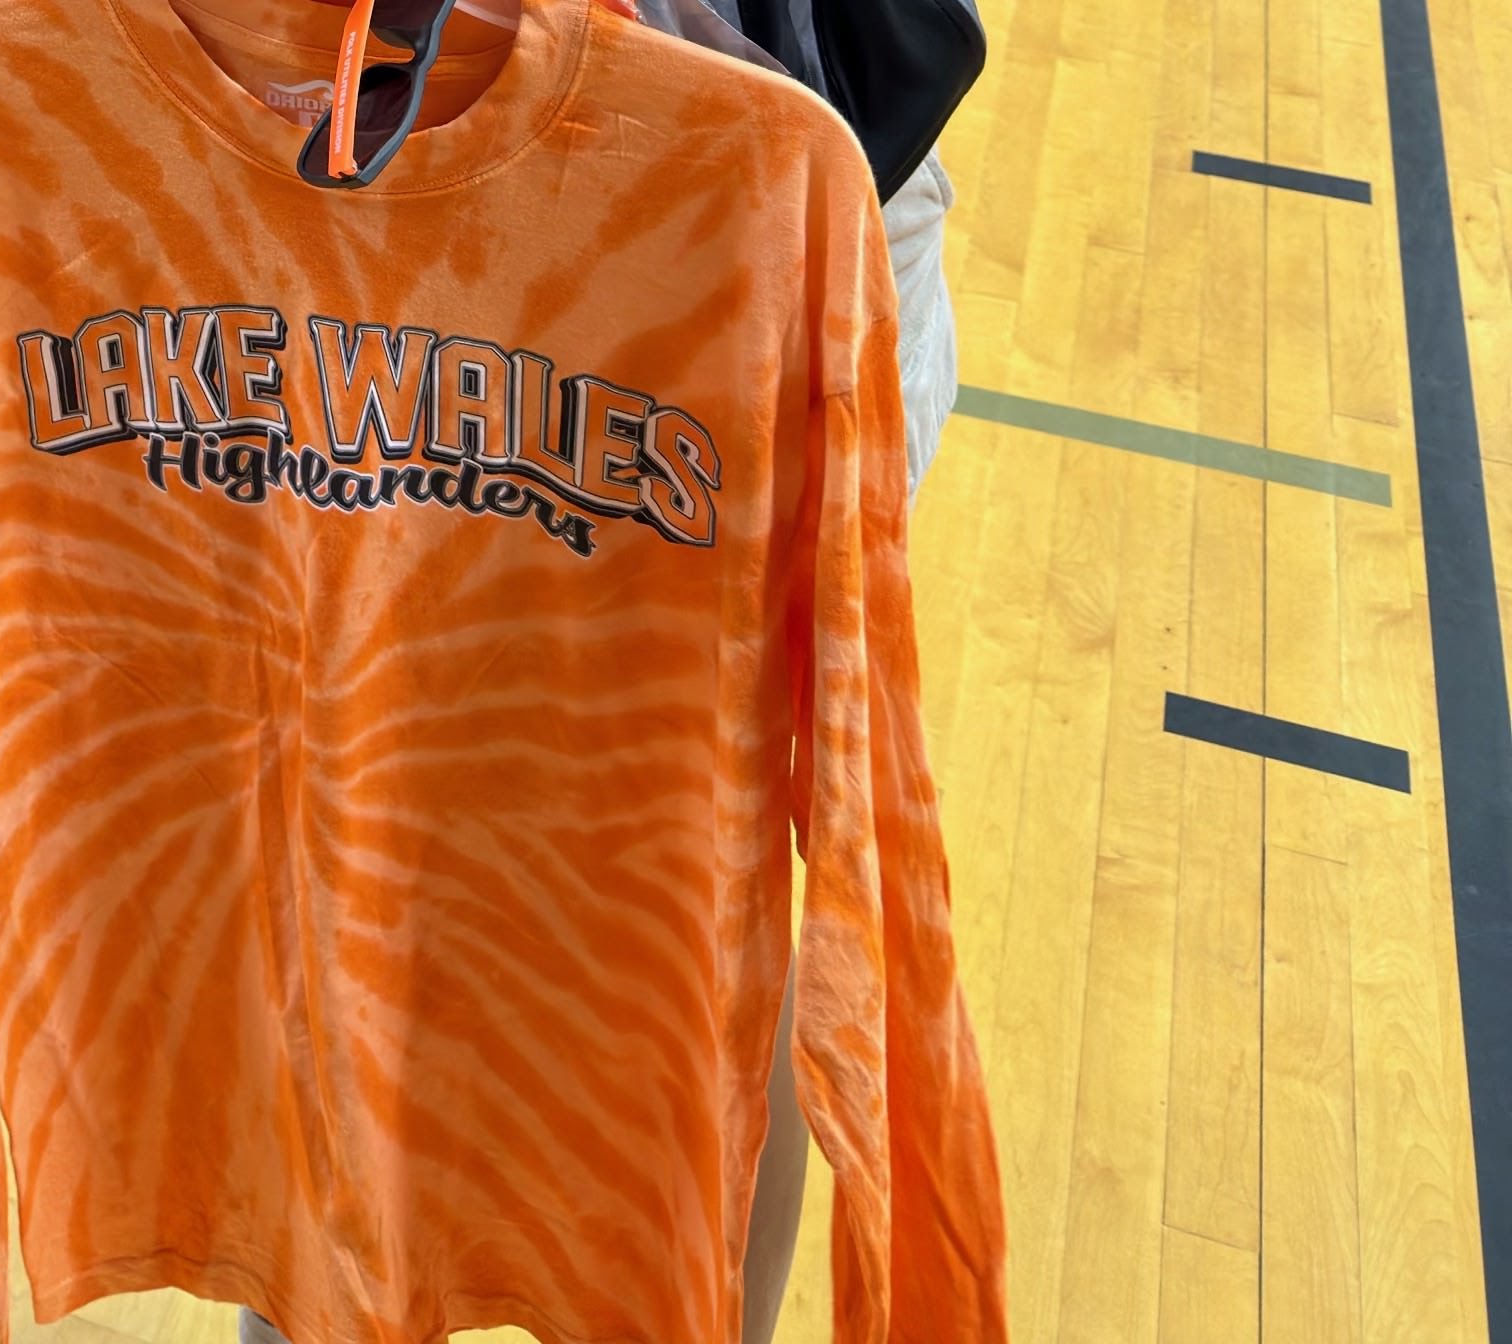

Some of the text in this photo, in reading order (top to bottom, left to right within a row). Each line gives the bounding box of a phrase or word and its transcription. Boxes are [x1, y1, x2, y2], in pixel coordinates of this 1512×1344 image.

[339, 58, 352, 105] UTILITIES
[334, 107, 345, 155] DIVISION
[16, 302, 724, 549] LAKE WALES
[142, 427, 599, 558] Highlanders
